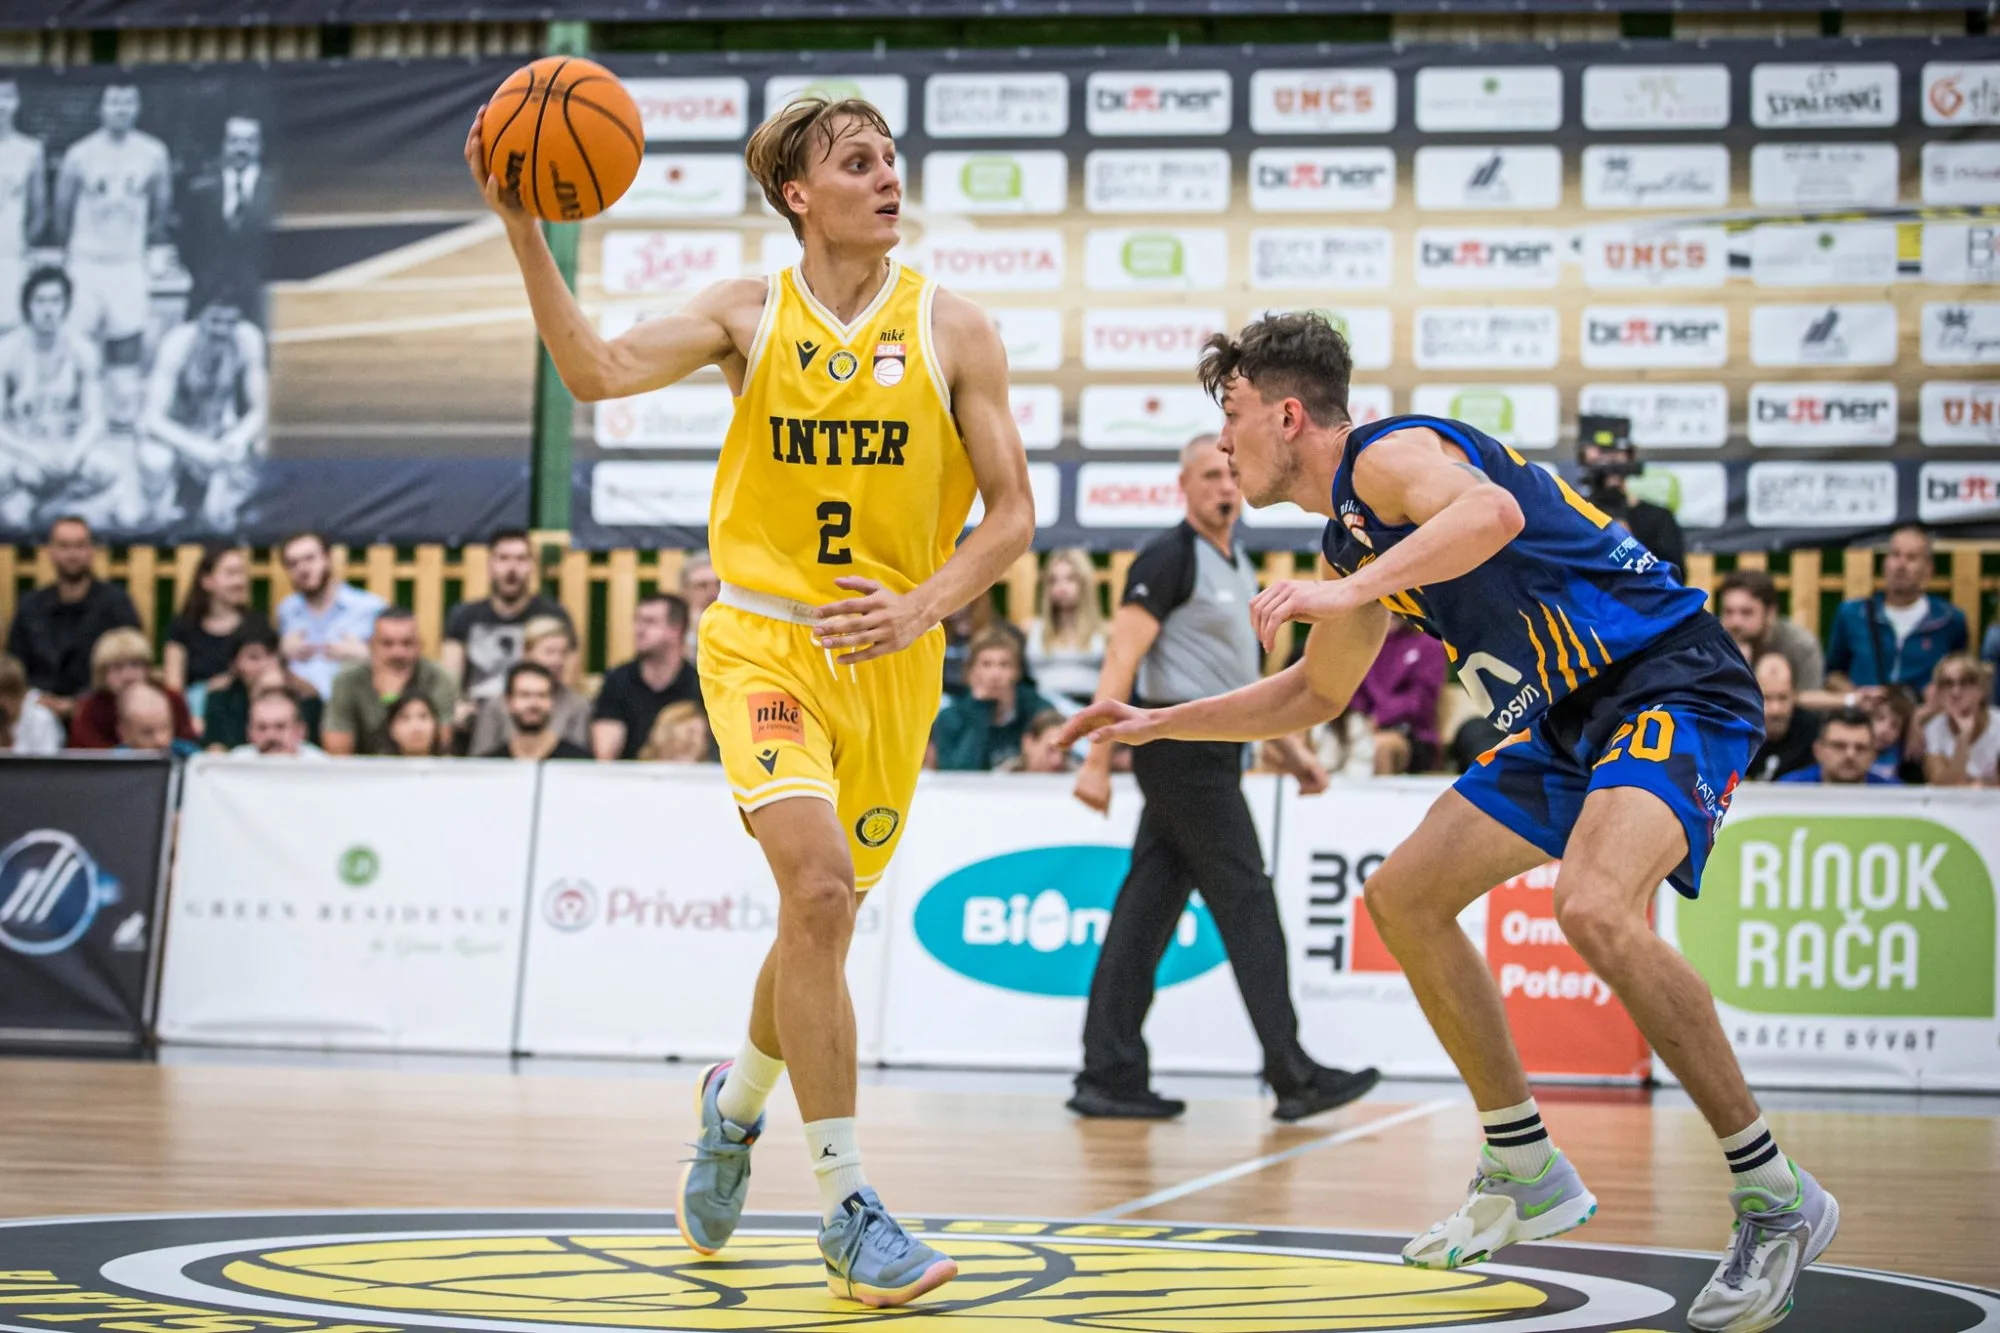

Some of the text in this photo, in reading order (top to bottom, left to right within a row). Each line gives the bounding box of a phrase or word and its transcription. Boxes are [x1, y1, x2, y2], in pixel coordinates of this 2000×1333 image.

[932, 249, 1054, 274] TOYOTA
[769, 416, 909, 466] INTER
[816, 501, 852, 565] 2
[1592, 710, 1676, 770] 20
[1736, 908, 1919, 990] RAČA
[1501, 962, 1613, 1005] Potery
